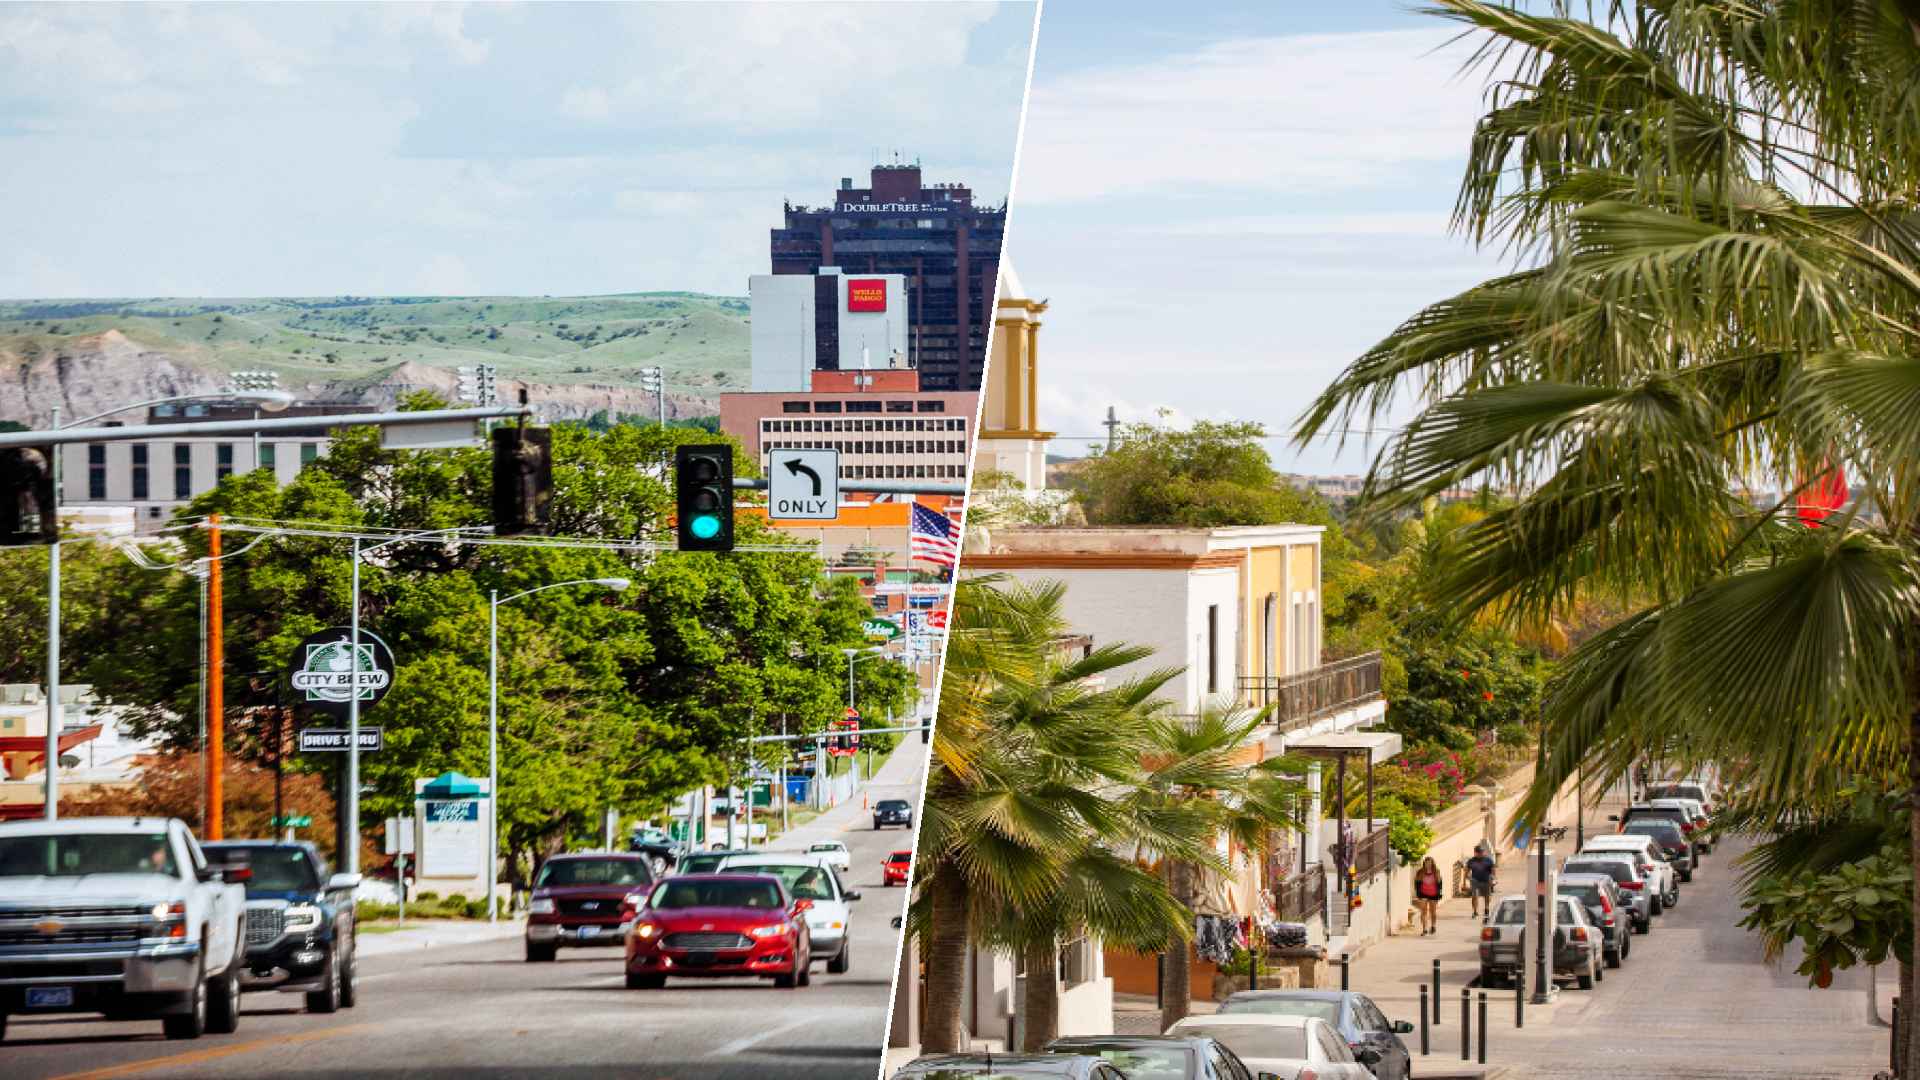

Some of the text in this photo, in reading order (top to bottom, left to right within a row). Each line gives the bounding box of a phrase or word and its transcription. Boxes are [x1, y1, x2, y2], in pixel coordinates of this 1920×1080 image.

[778, 499, 827, 514] ONLY
[297, 674, 332, 686] CITY
[303, 734, 377, 746] DRIVE TRU
